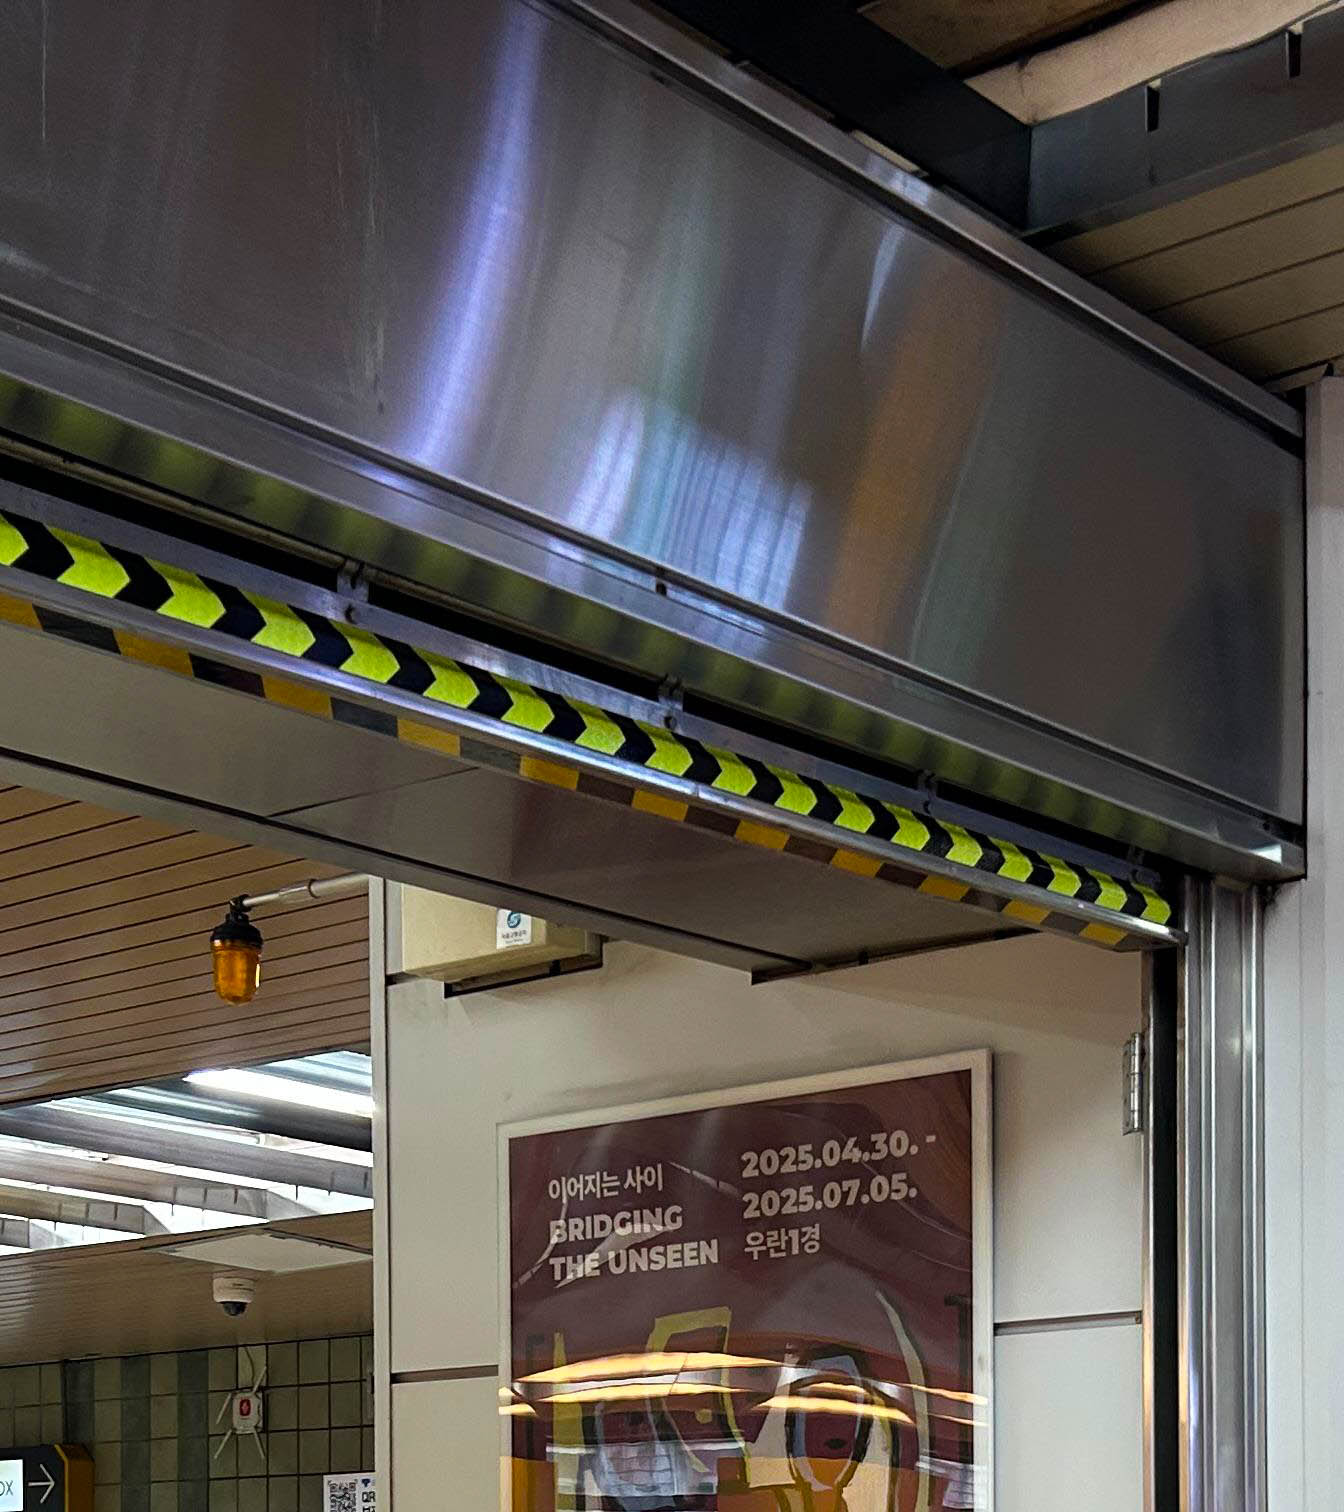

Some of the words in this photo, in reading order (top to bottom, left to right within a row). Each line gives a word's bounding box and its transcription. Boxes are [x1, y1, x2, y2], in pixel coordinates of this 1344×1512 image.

[740, 1130, 919, 1178] 2025.04.30.
[548, 1171, 620, 1202] 이어지는
[623, 1163, 663, 1194] 사이
[742, 1173, 918, 1219] 2025.07.05.
[549, 1205, 683, 1244] BRIDGING
[744, 1223, 821, 1260] 우란1경
[549, 1253, 601, 1281] THE
[608, 1239, 719, 1275] UNSEEN
